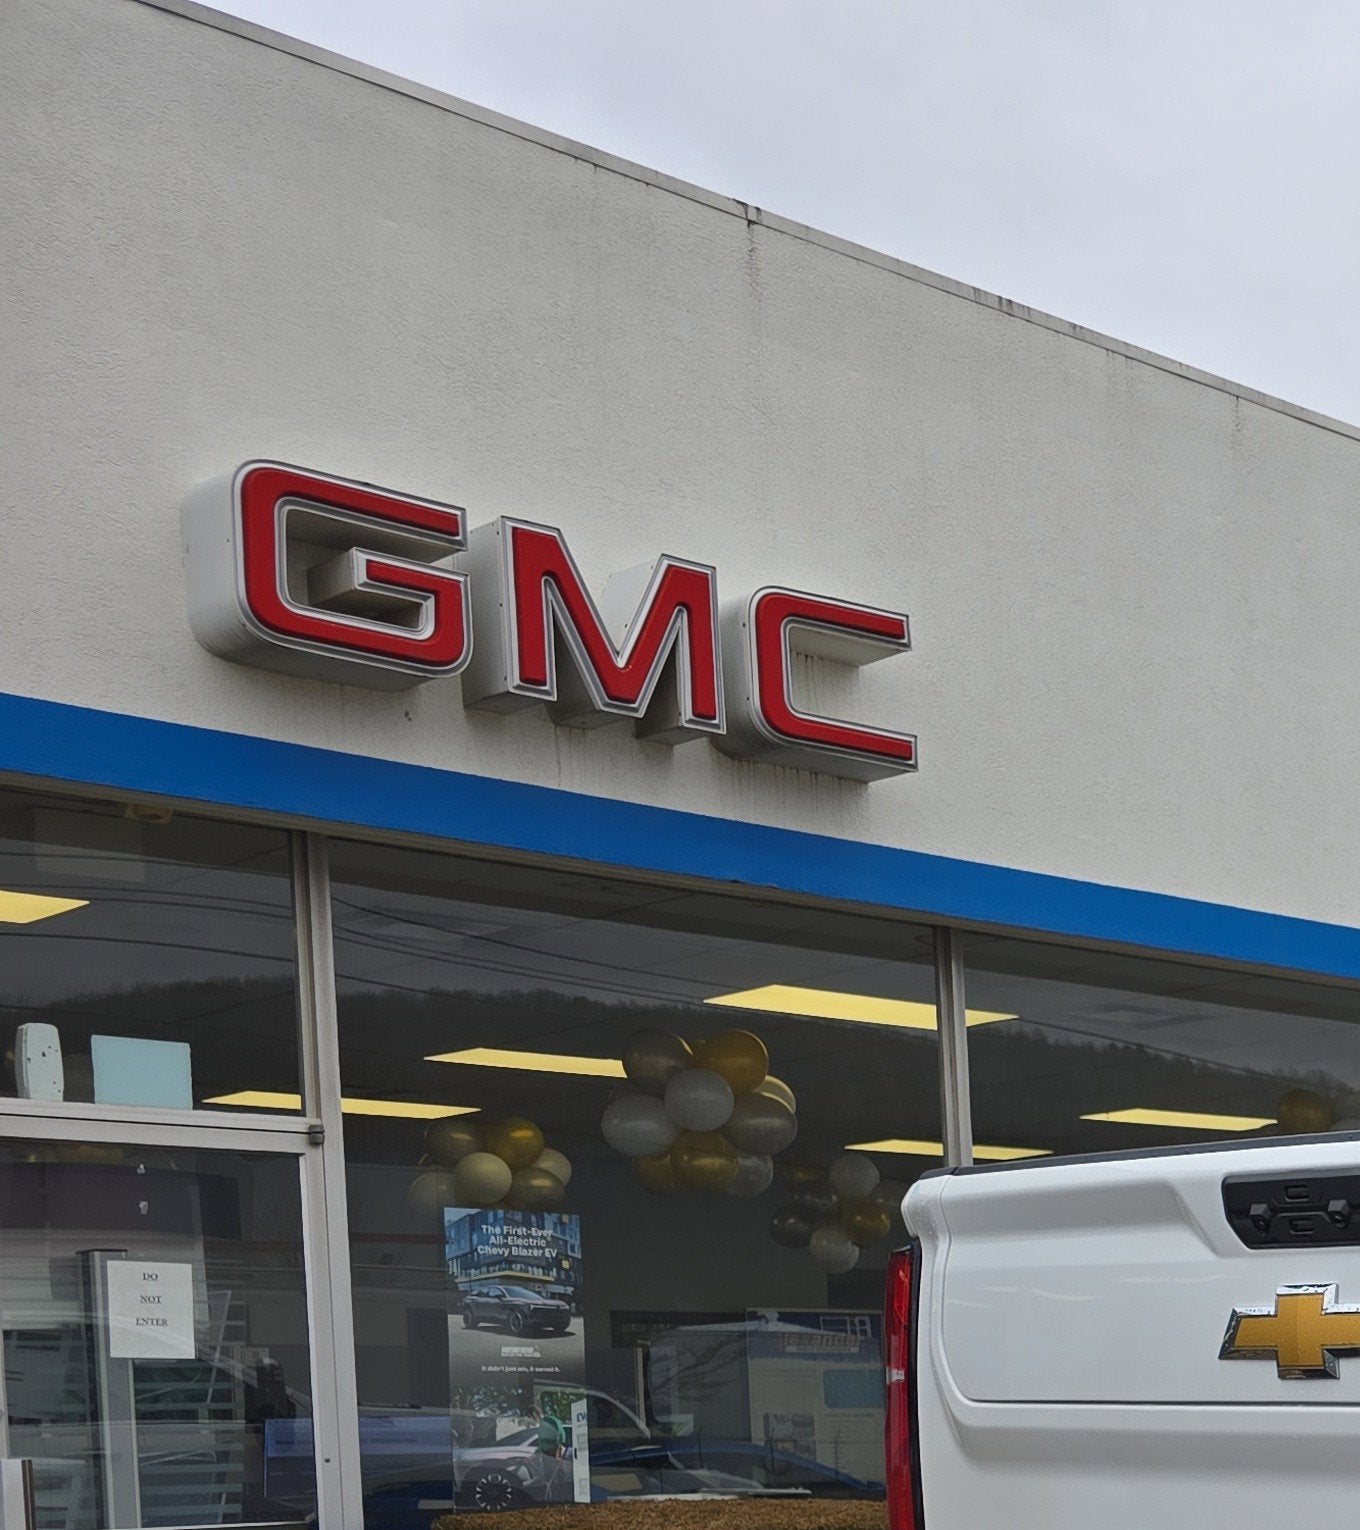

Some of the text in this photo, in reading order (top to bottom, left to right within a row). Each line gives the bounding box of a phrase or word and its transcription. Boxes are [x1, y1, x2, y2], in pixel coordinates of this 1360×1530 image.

[230, 458, 919, 773] GMC
[481, 1225, 553, 1238] The First-Ever
[489, 1235, 547, 1247] All-Electric
[477, 1245, 558, 1258] Chevy Blazer EV
[142, 1272, 158, 1281] DO
[140, 1294, 162, 1304] NOT
[135, 1317, 168, 1327] ENTER
